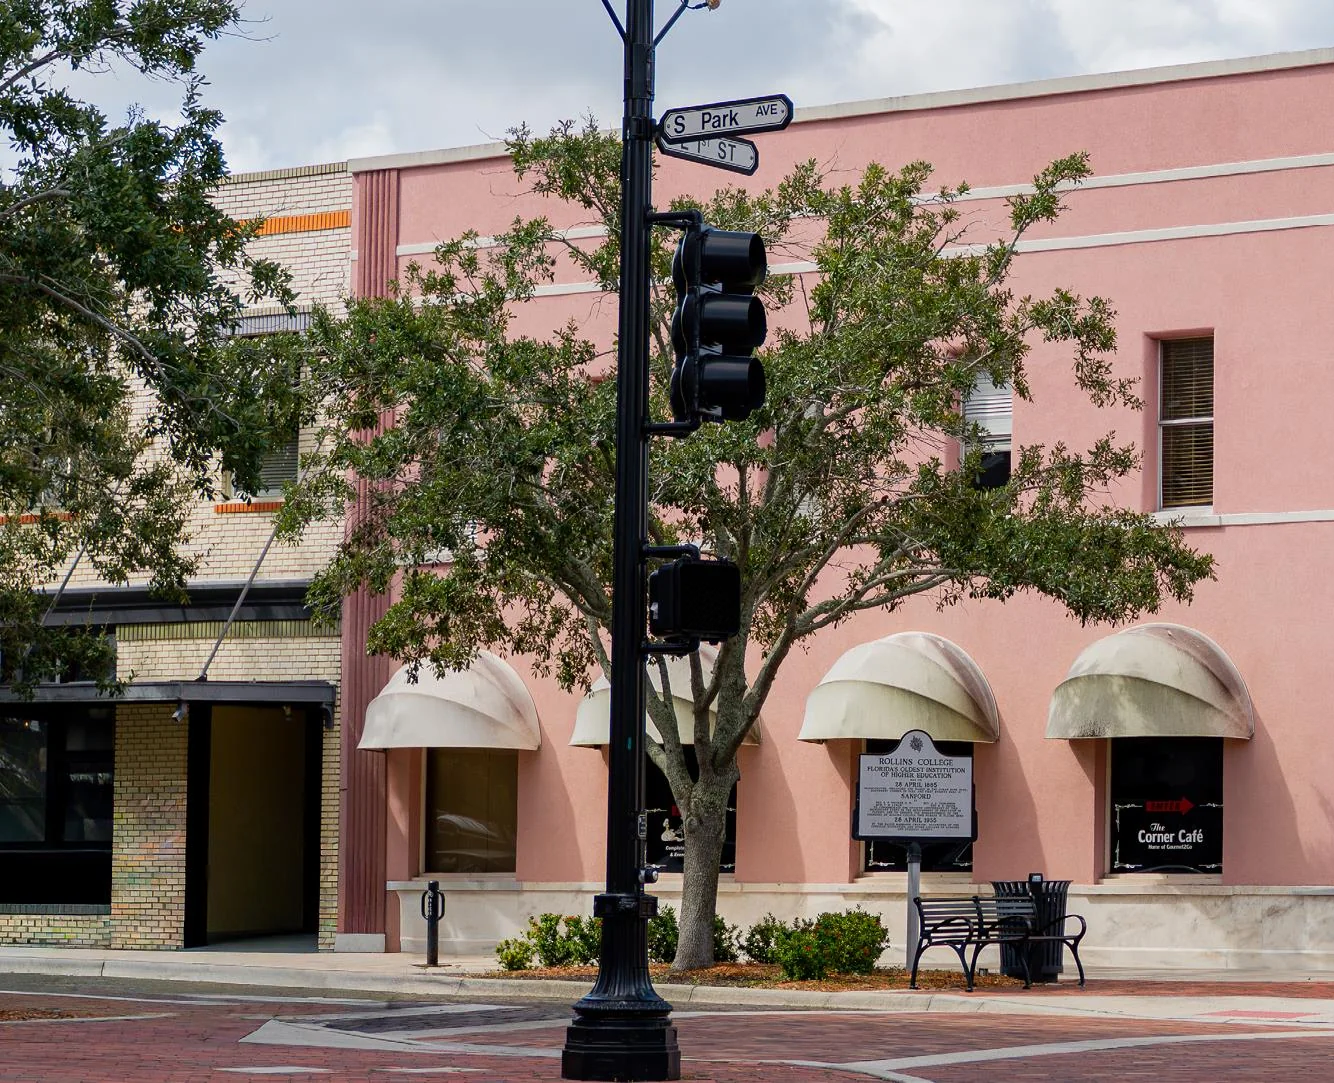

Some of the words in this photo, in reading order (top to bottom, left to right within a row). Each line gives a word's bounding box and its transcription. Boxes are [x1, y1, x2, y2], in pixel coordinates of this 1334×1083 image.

[674, 115, 686, 134] S
[701, 109, 739, 130] Park
[755, 103, 778, 117] AVE
[718, 142, 736, 161] ST
[879, 757, 913, 766] ROLLINS
[917, 758, 954, 767] COLLEGE
[1150, 822, 1166, 832] The
[1138, 830, 1175, 843] Corner
[1178, 828, 1204, 843] Café
